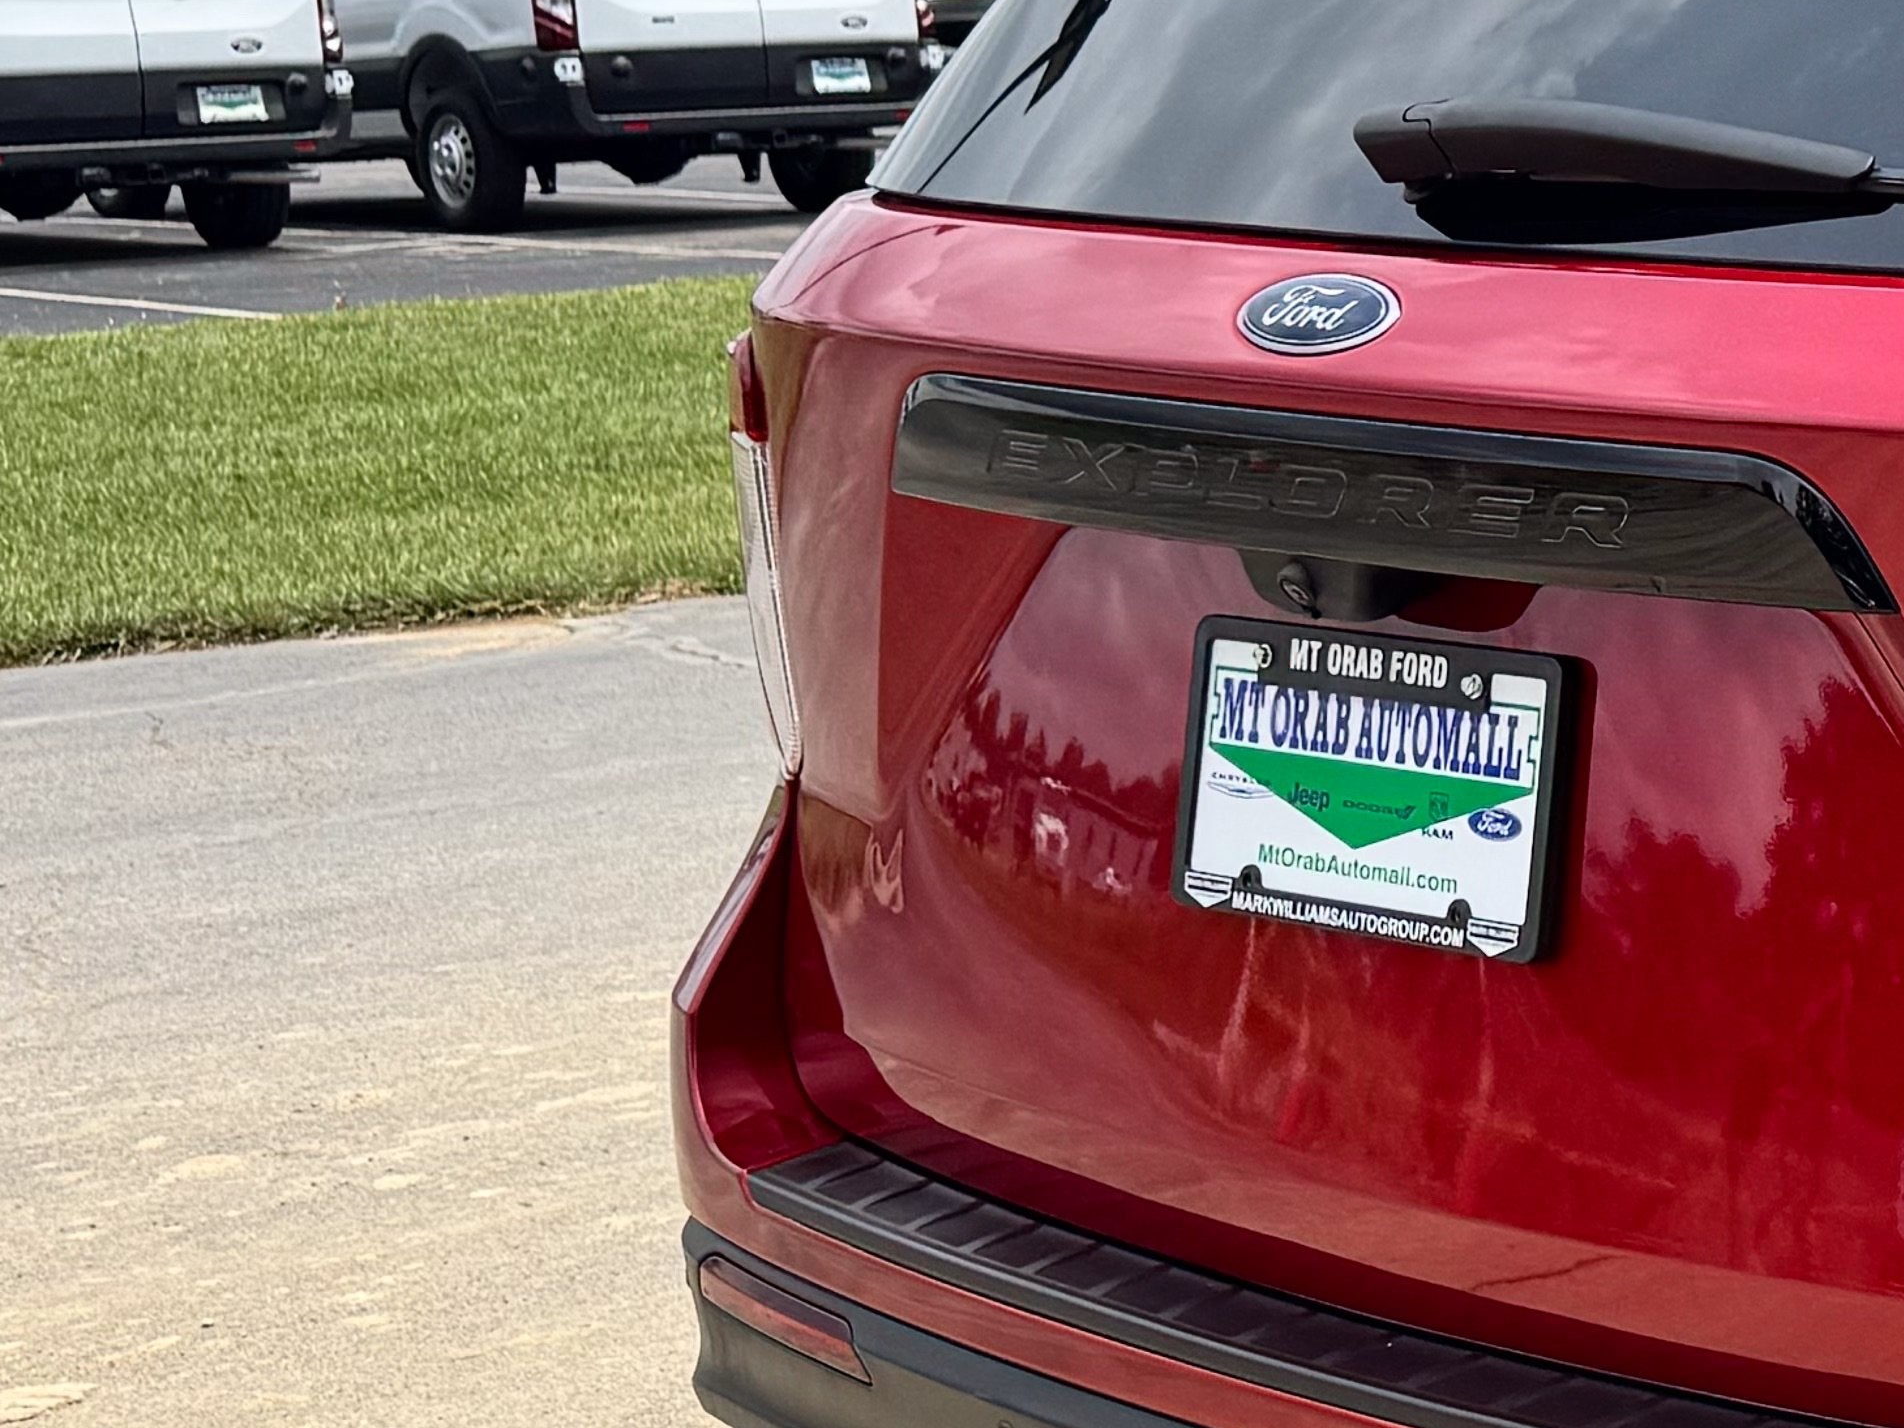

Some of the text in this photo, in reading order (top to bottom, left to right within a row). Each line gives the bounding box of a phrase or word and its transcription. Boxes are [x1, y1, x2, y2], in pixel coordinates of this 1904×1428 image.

[1262, 285, 1359, 331] Ford
[987, 429, 1630, 548] EXPLORER
[1290, 638, 1448, 689] MT ORAB FORD
[1219, 677, 1523, 781] MT ORAB AUTOMALL
[1212, 771, 1270, 788] CHRYS
[1288, 782, 1330, 812] Jeep
[1422, 828, 1453, 840] RAM
[1477, 811, 1512, 836] Ford
[1258, 843, 1458, 895] MtOrabAutomall.com
[1232, 891, 1465, 948] MARKWILLIAMSAUTOGROUP.COM
